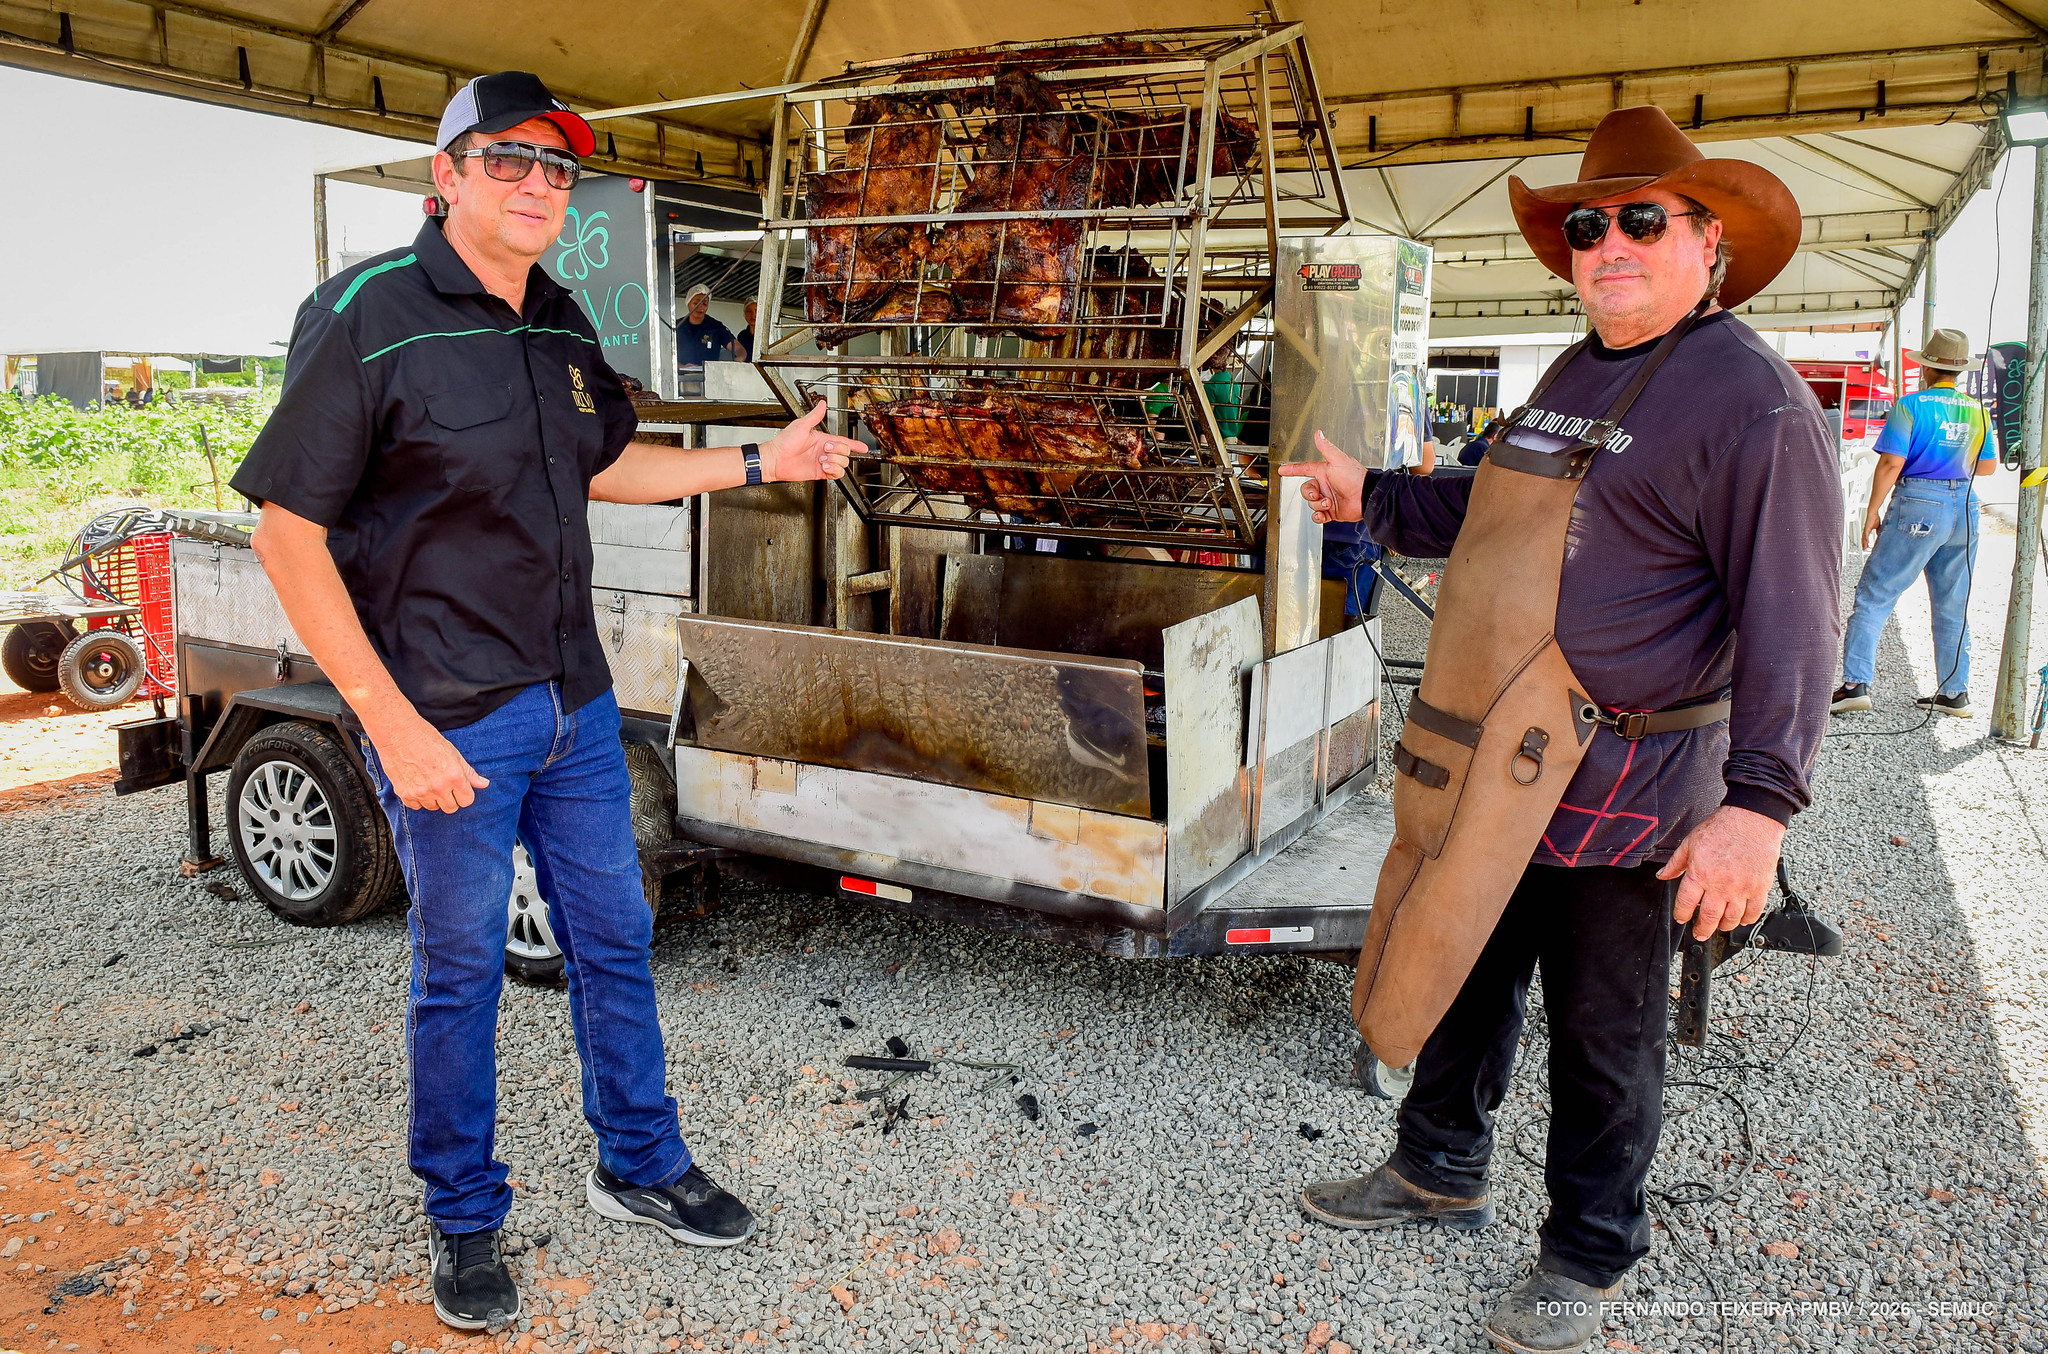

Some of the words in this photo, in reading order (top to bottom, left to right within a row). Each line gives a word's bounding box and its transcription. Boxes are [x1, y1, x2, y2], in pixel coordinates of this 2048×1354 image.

[602, 333, 639, 347] ANTE
[1537, 411, 1566, 433] DO
[248, 740, 298, 757] COMFORT
